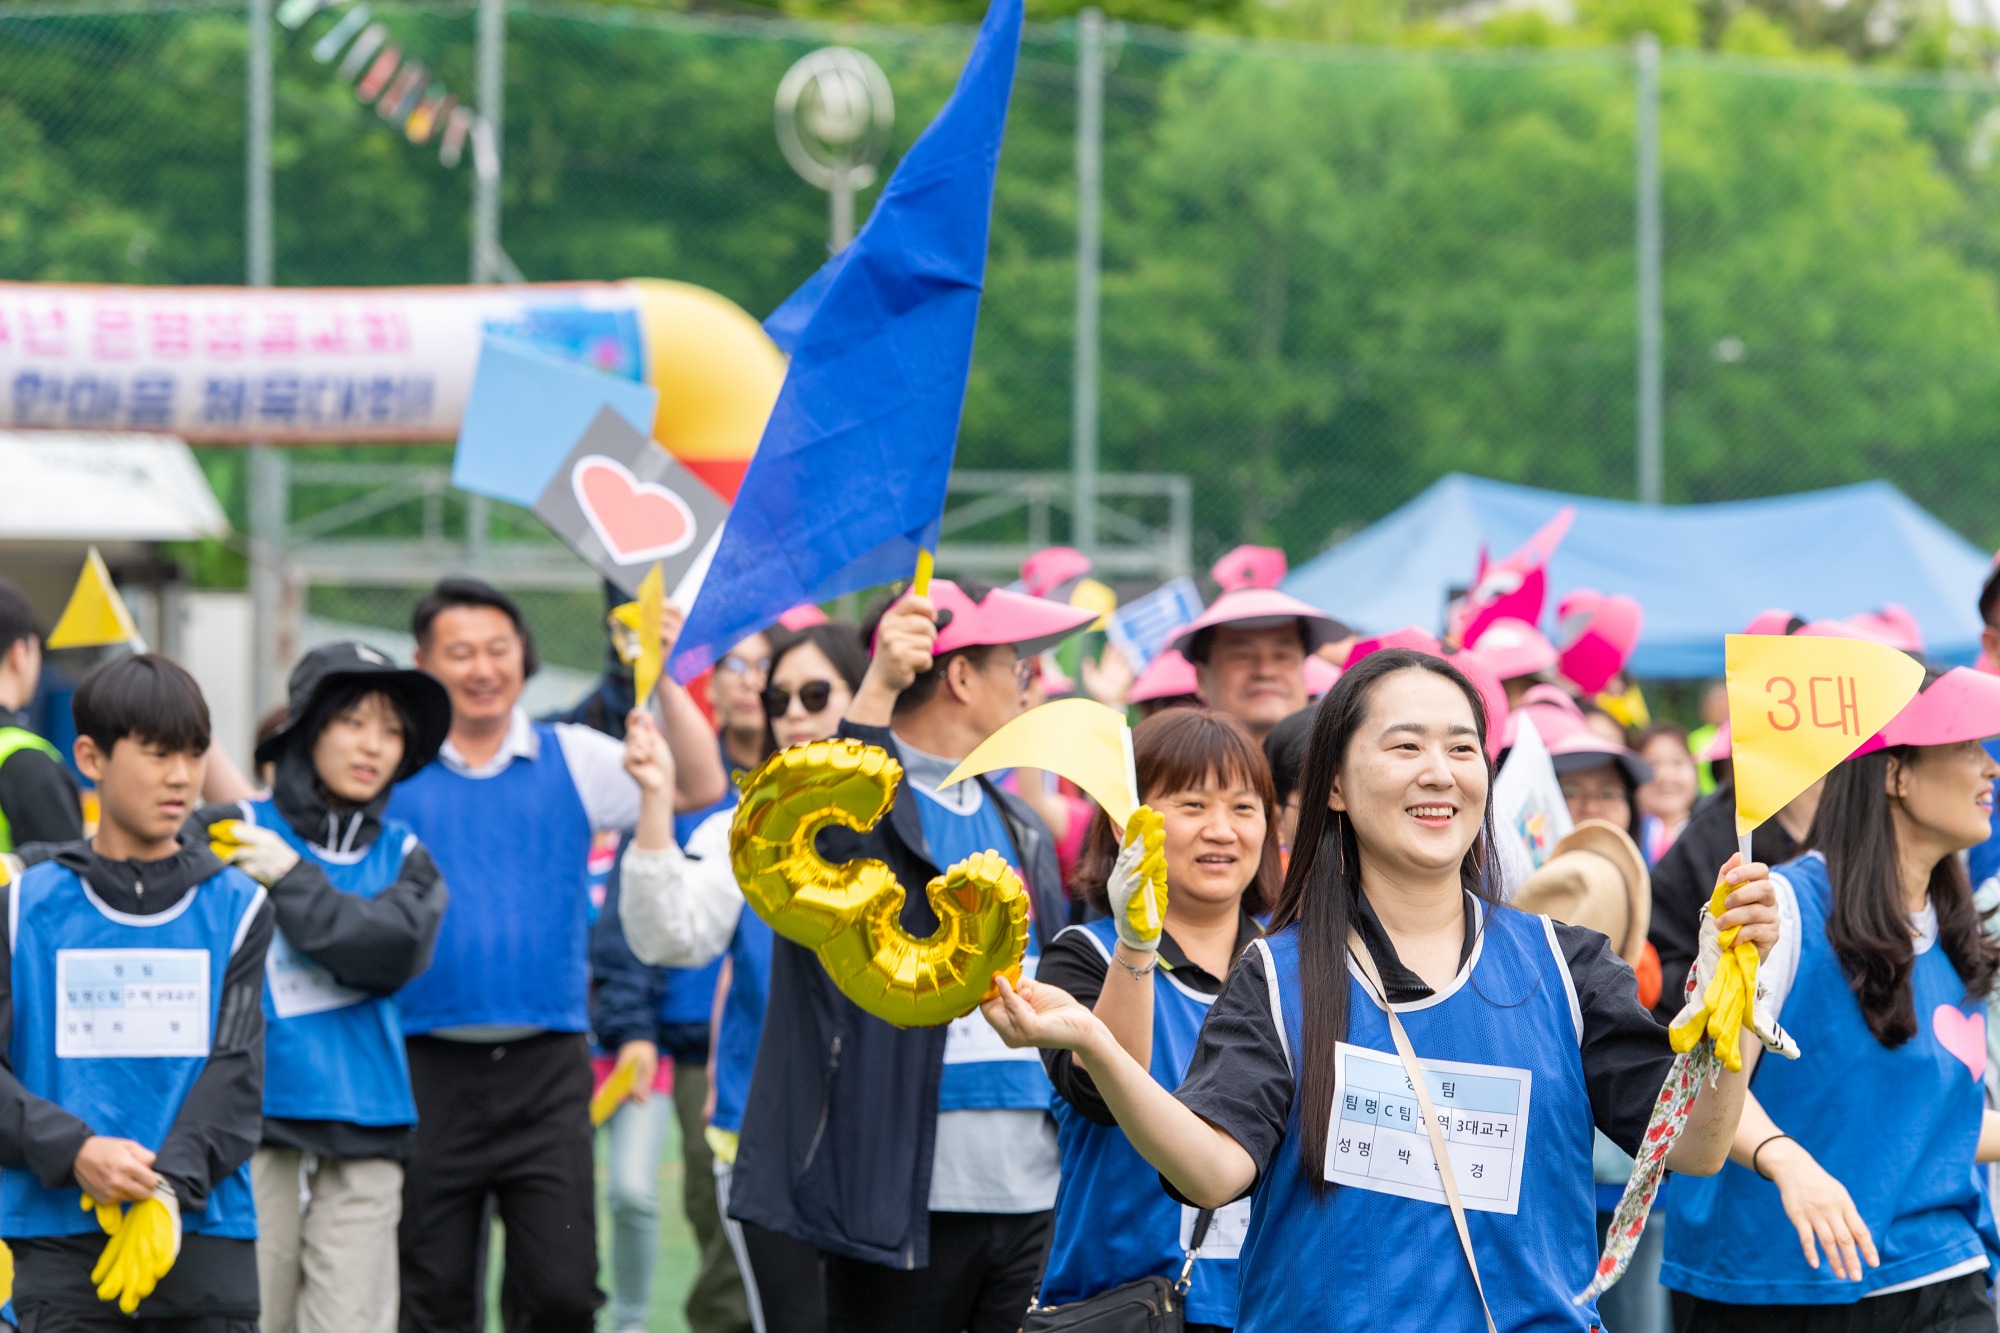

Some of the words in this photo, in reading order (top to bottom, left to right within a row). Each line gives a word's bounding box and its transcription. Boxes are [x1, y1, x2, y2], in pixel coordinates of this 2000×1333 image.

[1765, 675, 1861, 737] 3대
[1441, 1081, 1456, 1099] 팀
[1456, 1119, 1509, 1138] 3대교구
